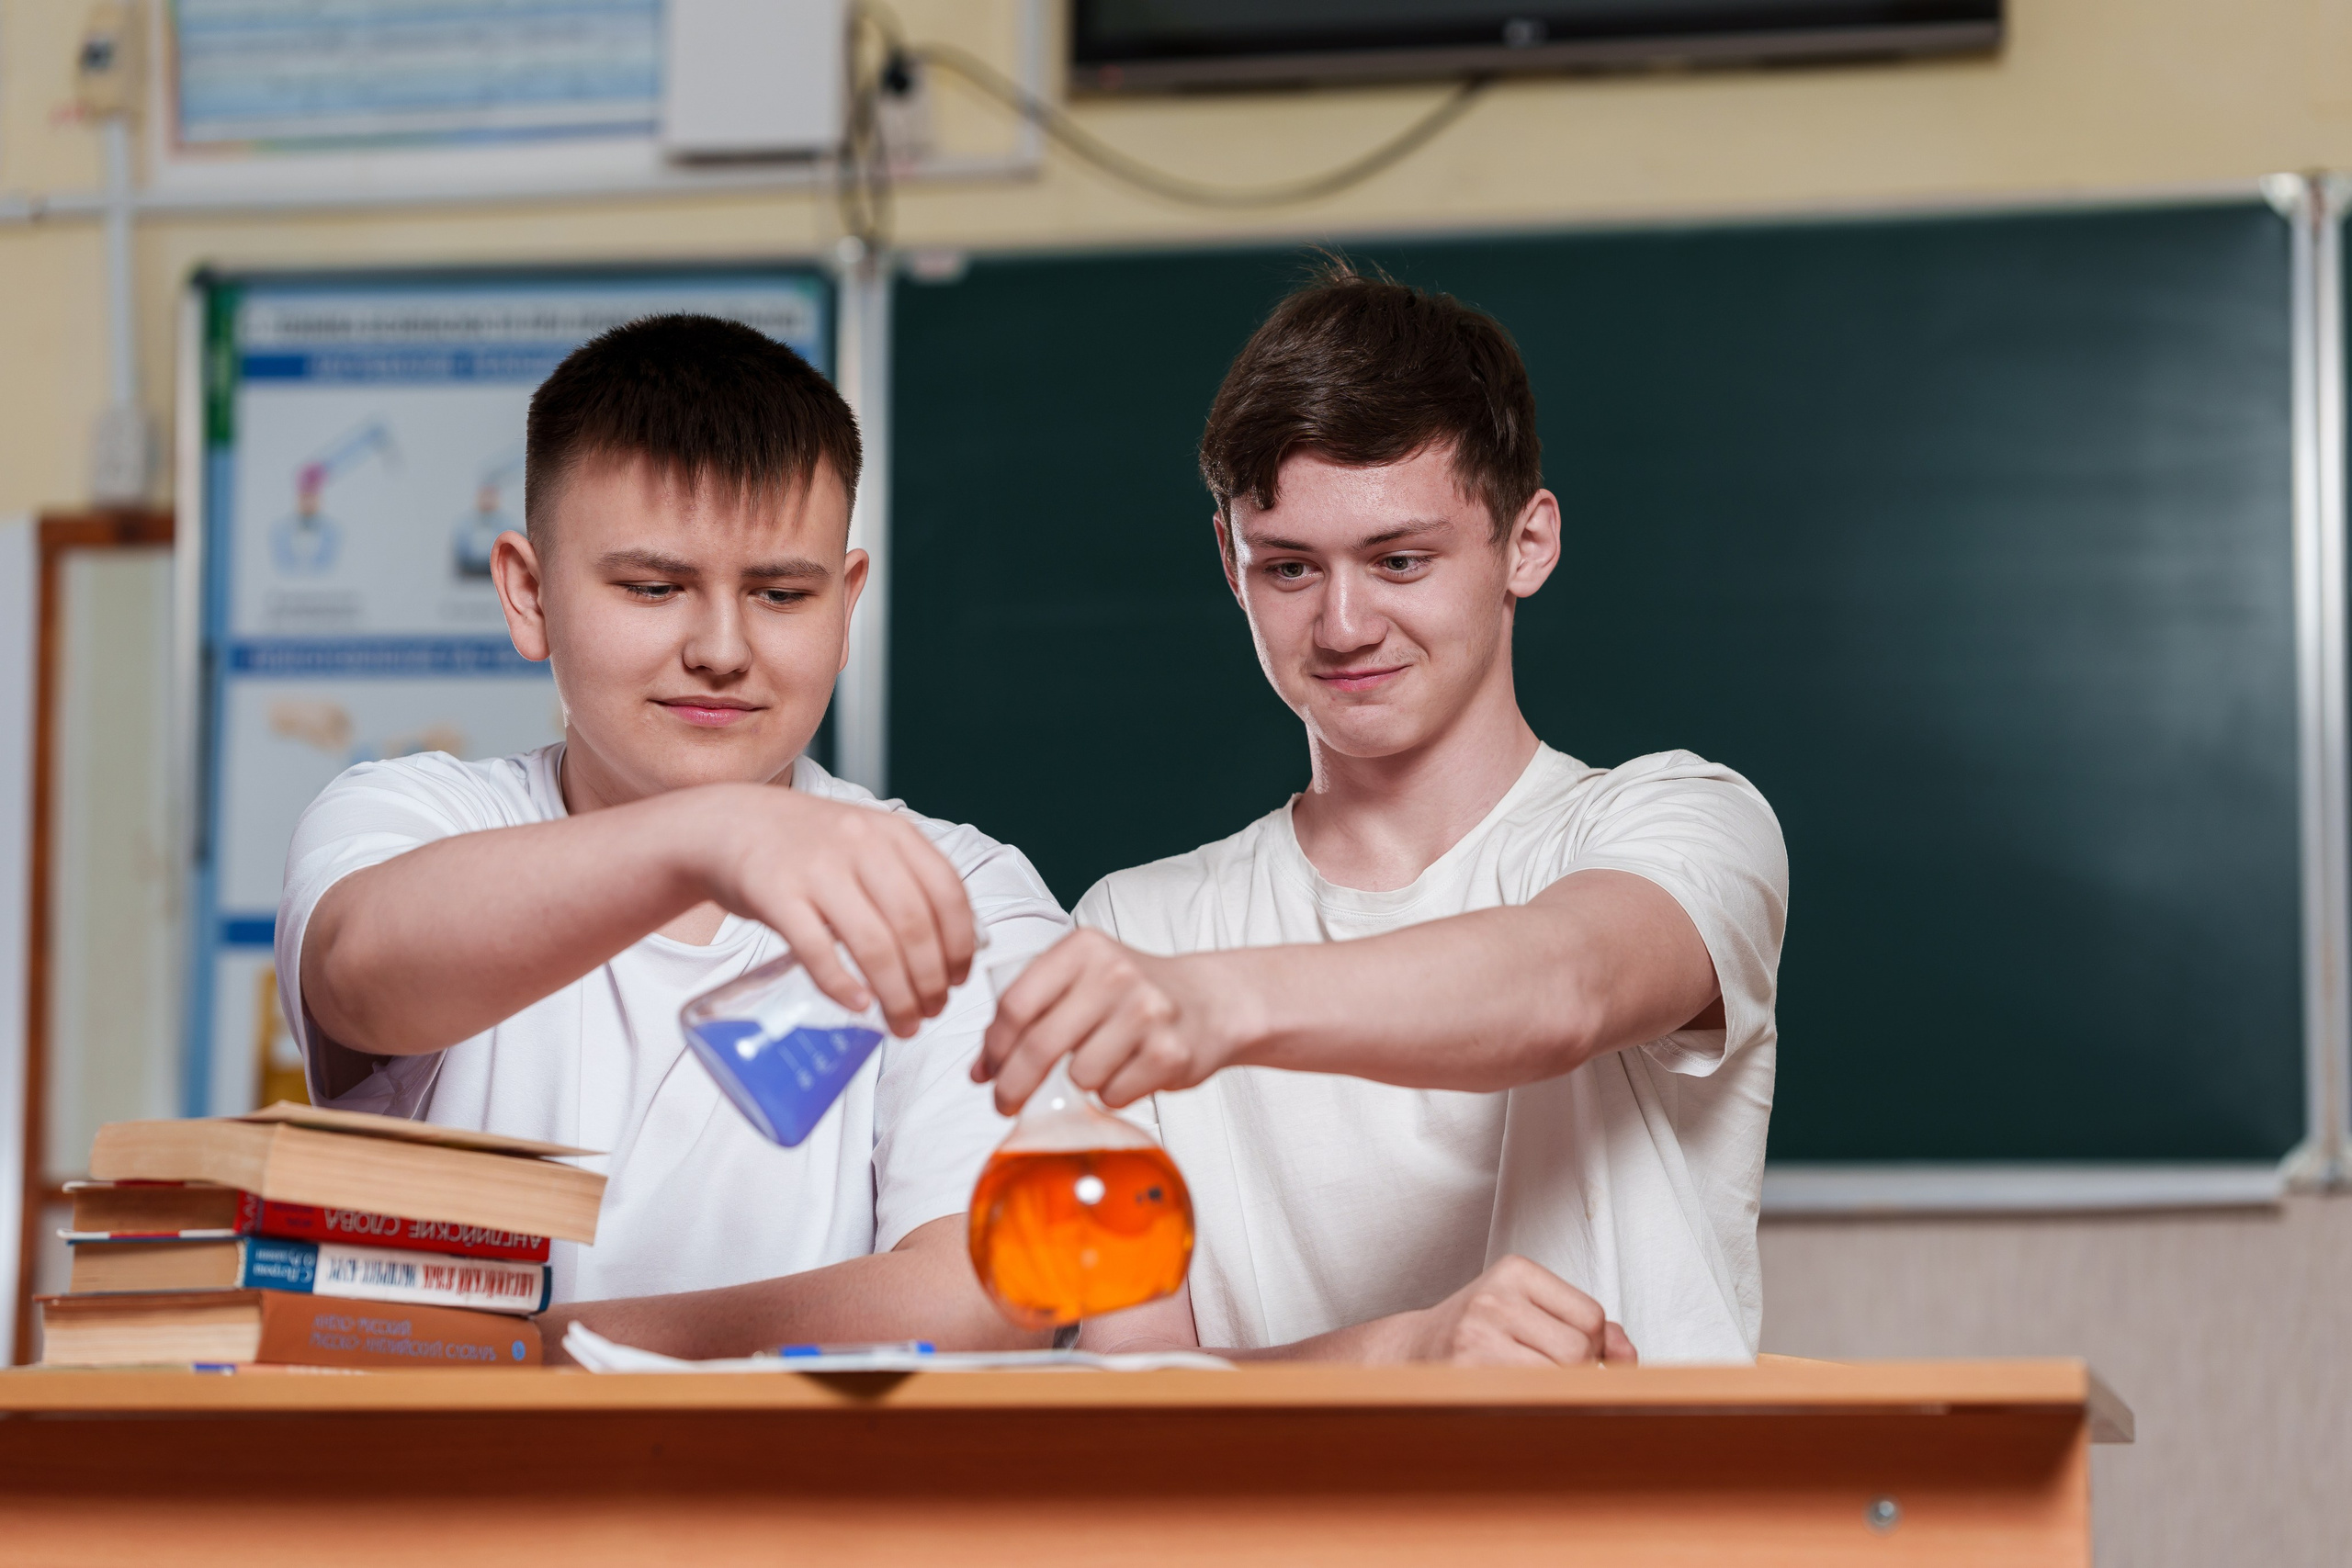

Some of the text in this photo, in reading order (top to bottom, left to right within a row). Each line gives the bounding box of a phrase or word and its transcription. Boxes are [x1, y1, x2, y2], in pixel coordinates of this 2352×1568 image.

[323, 1208, 544, 1250] АНГЛИЙСКИЕ СЛОВА
[422, 1264, 457, 1290] ЯЗЫК
[456, 1267, 534, 1298] АНГЛИЙСКИЙ
